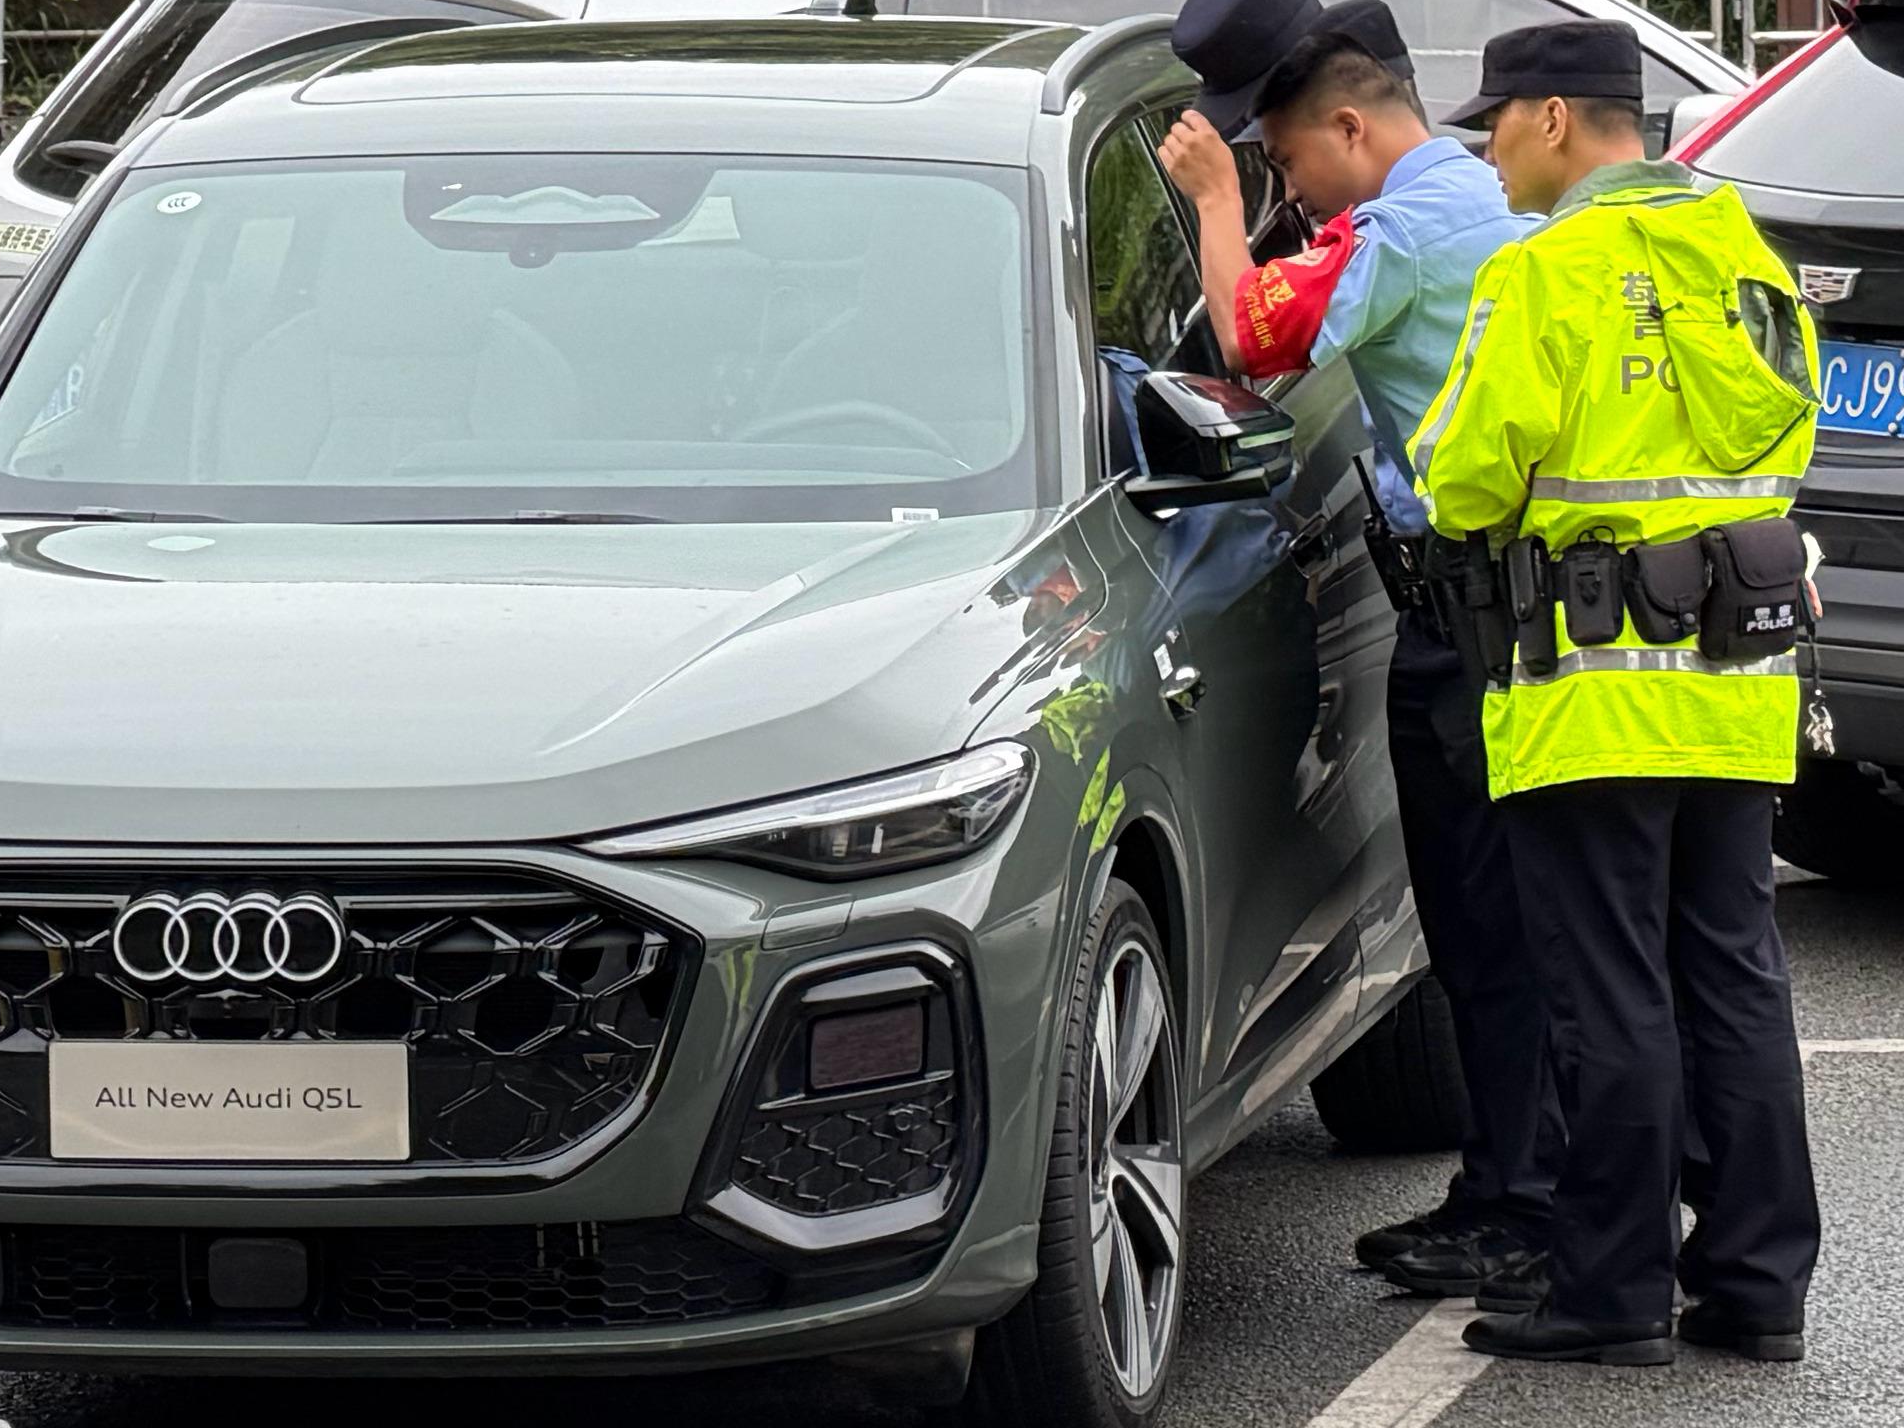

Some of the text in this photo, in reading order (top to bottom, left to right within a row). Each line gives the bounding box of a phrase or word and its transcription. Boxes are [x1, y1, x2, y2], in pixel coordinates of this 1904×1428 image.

[95, 1086, 363, 1113] All New Audi Q5L
